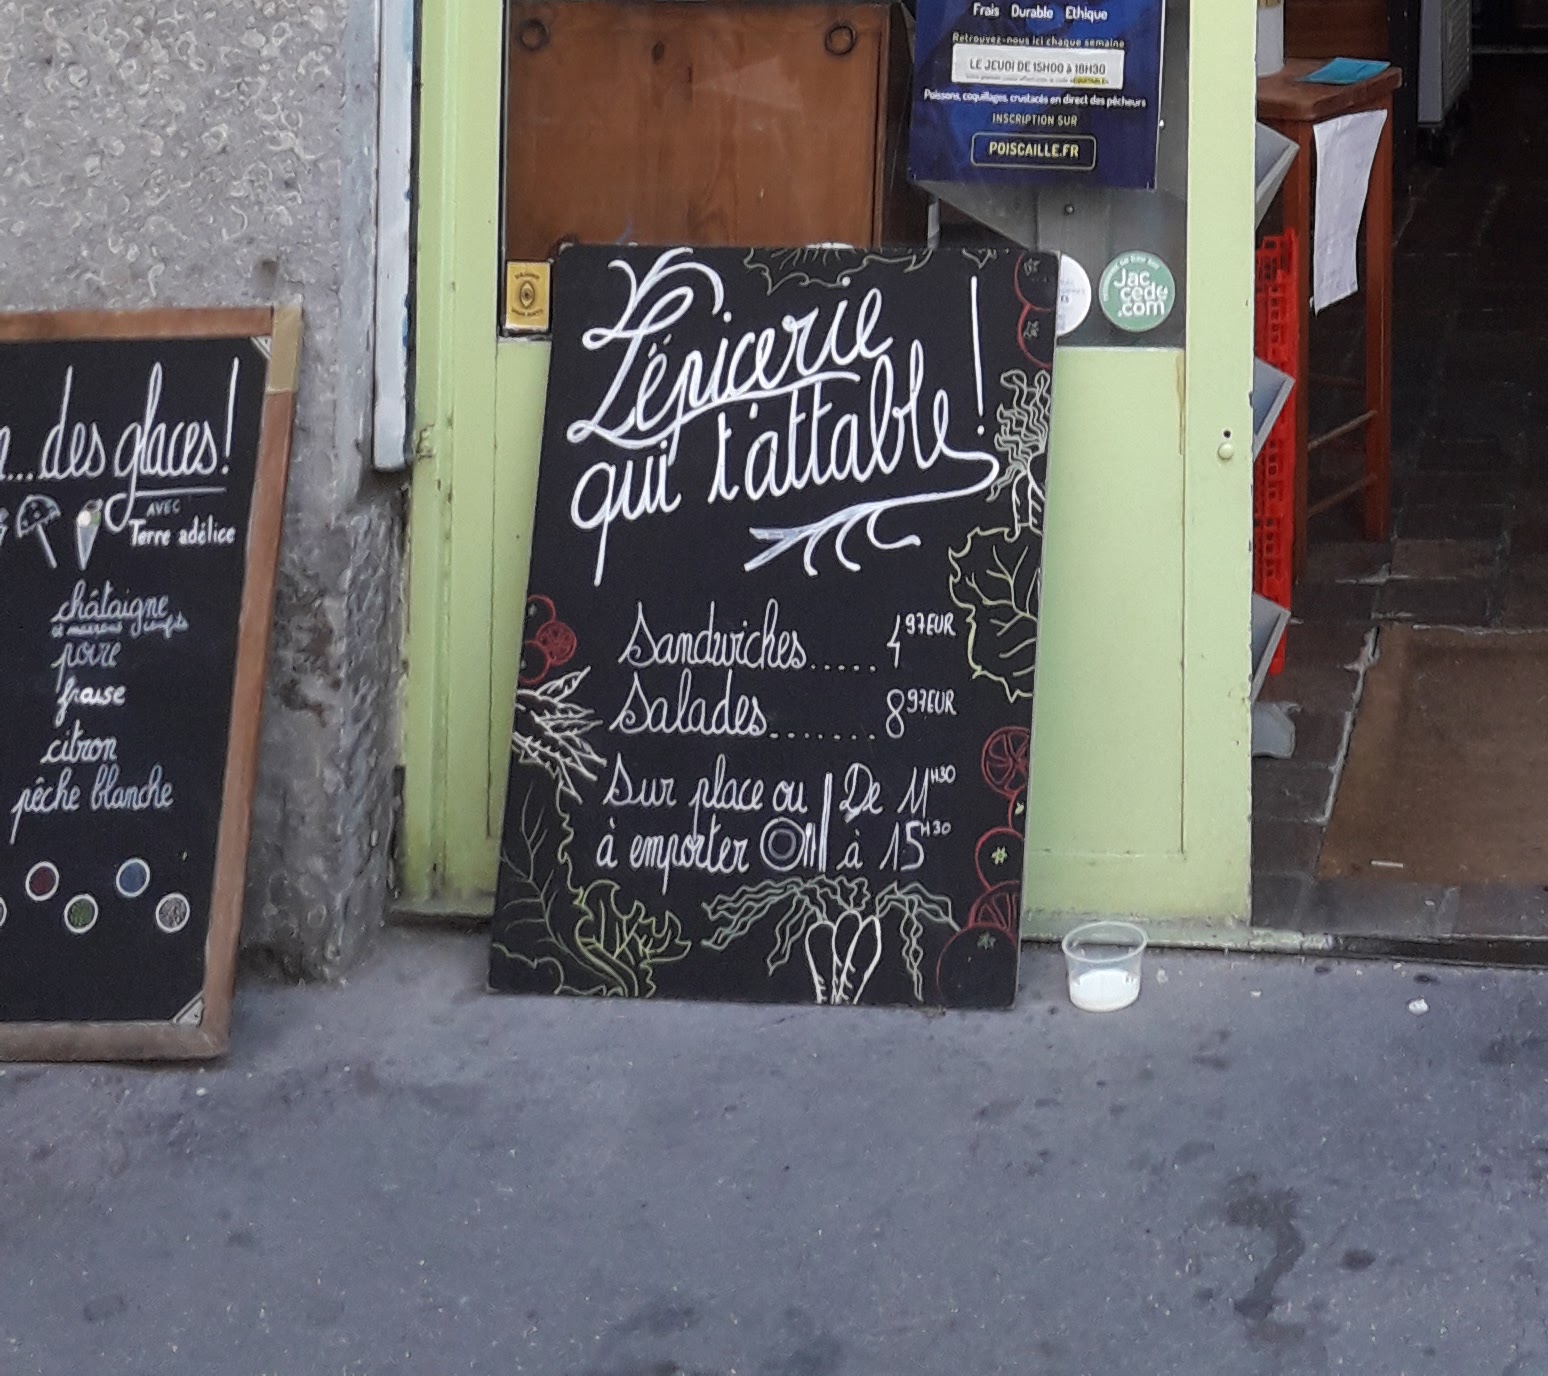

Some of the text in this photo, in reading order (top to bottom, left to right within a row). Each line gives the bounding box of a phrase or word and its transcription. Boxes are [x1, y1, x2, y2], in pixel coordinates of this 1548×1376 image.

[973, 1, 1108, 22] Frais Durable Ethique
[968, 58, 982, 70] LE
[1017, 60, 1030, 72] DE
[992, 112, 1078, 128] INSCRIPTION SUR
[1063, 93, 1088, 106] direct
[988, 141, 1080, 159] POISCAILLE.FR
[1117, 300, 1166, 318] .com
[38, 363, 106, 481] des
[128, 514, 237, 547] Terre adélice
[146, 499, 182, 517] AVEC
[570, 448, 683, 587] qui
[51, 640, 122, 693] poire
[55, 675, 127, 728] fraise
[609, 668, 768, 737] Salades
[39, 718, 118, 765] citron
[10, 762, 174, 846] pêche blanche
[603, 751, 809, 842] Sur place ou
[630, 812, 751, 896] emporter
